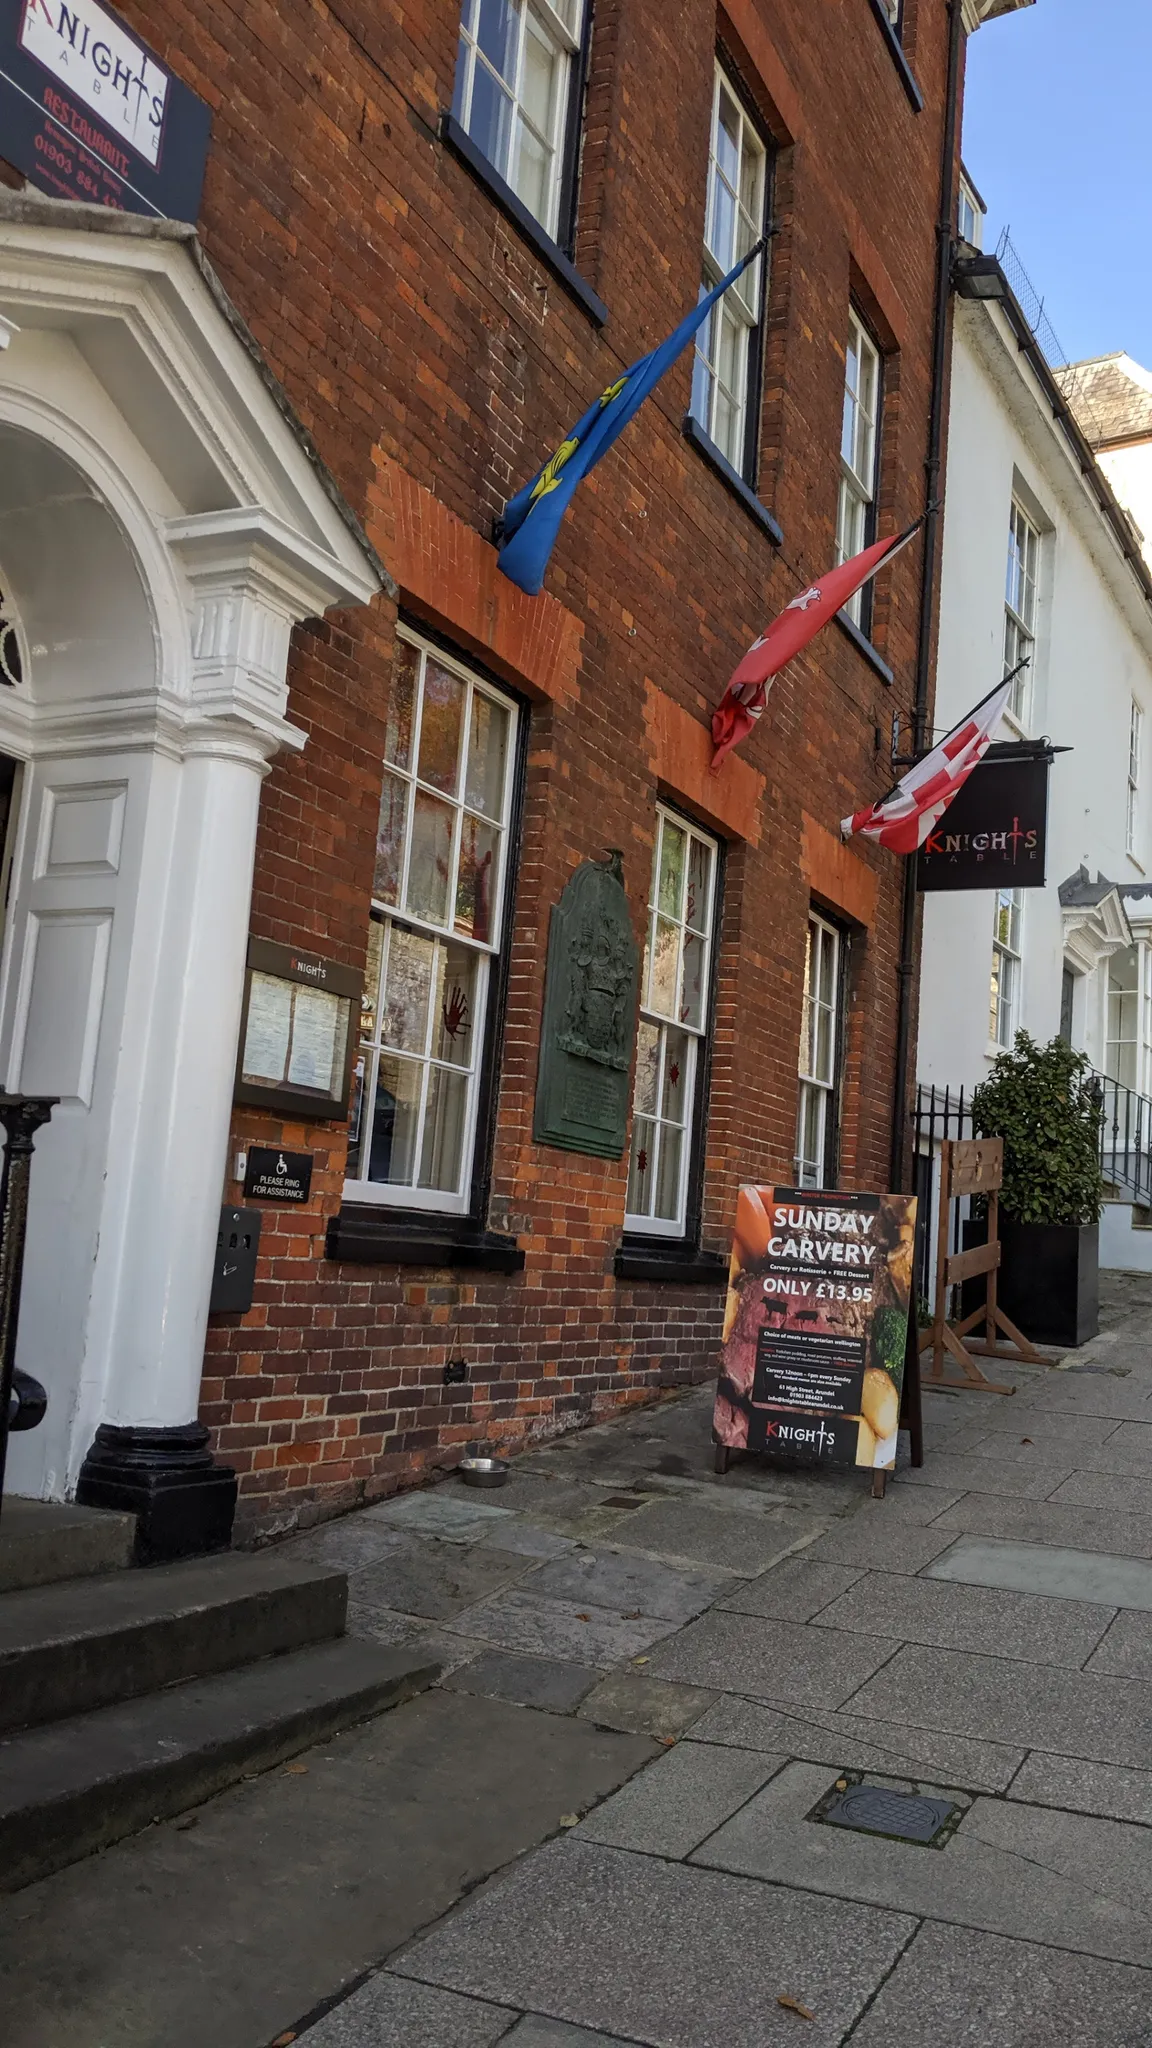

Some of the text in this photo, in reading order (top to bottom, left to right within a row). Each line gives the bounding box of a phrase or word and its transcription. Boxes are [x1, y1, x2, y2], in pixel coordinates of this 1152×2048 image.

[26, 15, 160, 150] TABLE
[925, 818, 1038, 860] KNIGHTS
[924, 851, 1037, 864] TABLE
[290, 957, 327, 979] KNIGHTS
[260, 1175, 300, 1188] PLEASE RING
[252, 1185, 304, 1199] FOR ASSISTANCE
[773, 1208, 875, 1234] SUNDAY
[767, 1237, 876, 1265] CARVERY
[770, 1263, 791, 1272] Carvery
[799, 1266, 826, 1275] Rotisserie
[833, 1269, 847, 1277] FREE
[848, 1271, 869, 1279] Dessert
[763, 1278, 872, 1303] ONLY £13.95
[808, 1336, 833, 1344] vegetarian
[834, 1340, 861, 1348] wellington
[766, 1367, 784, 1375] Carvery
[833, 1375, 852, 1384] Sunday
[815, 1389, 835, 1397] Arundel
[766, 1421, 836, 1451] KNIGHTS
[765, 1439, 833, 1454] TABLE
